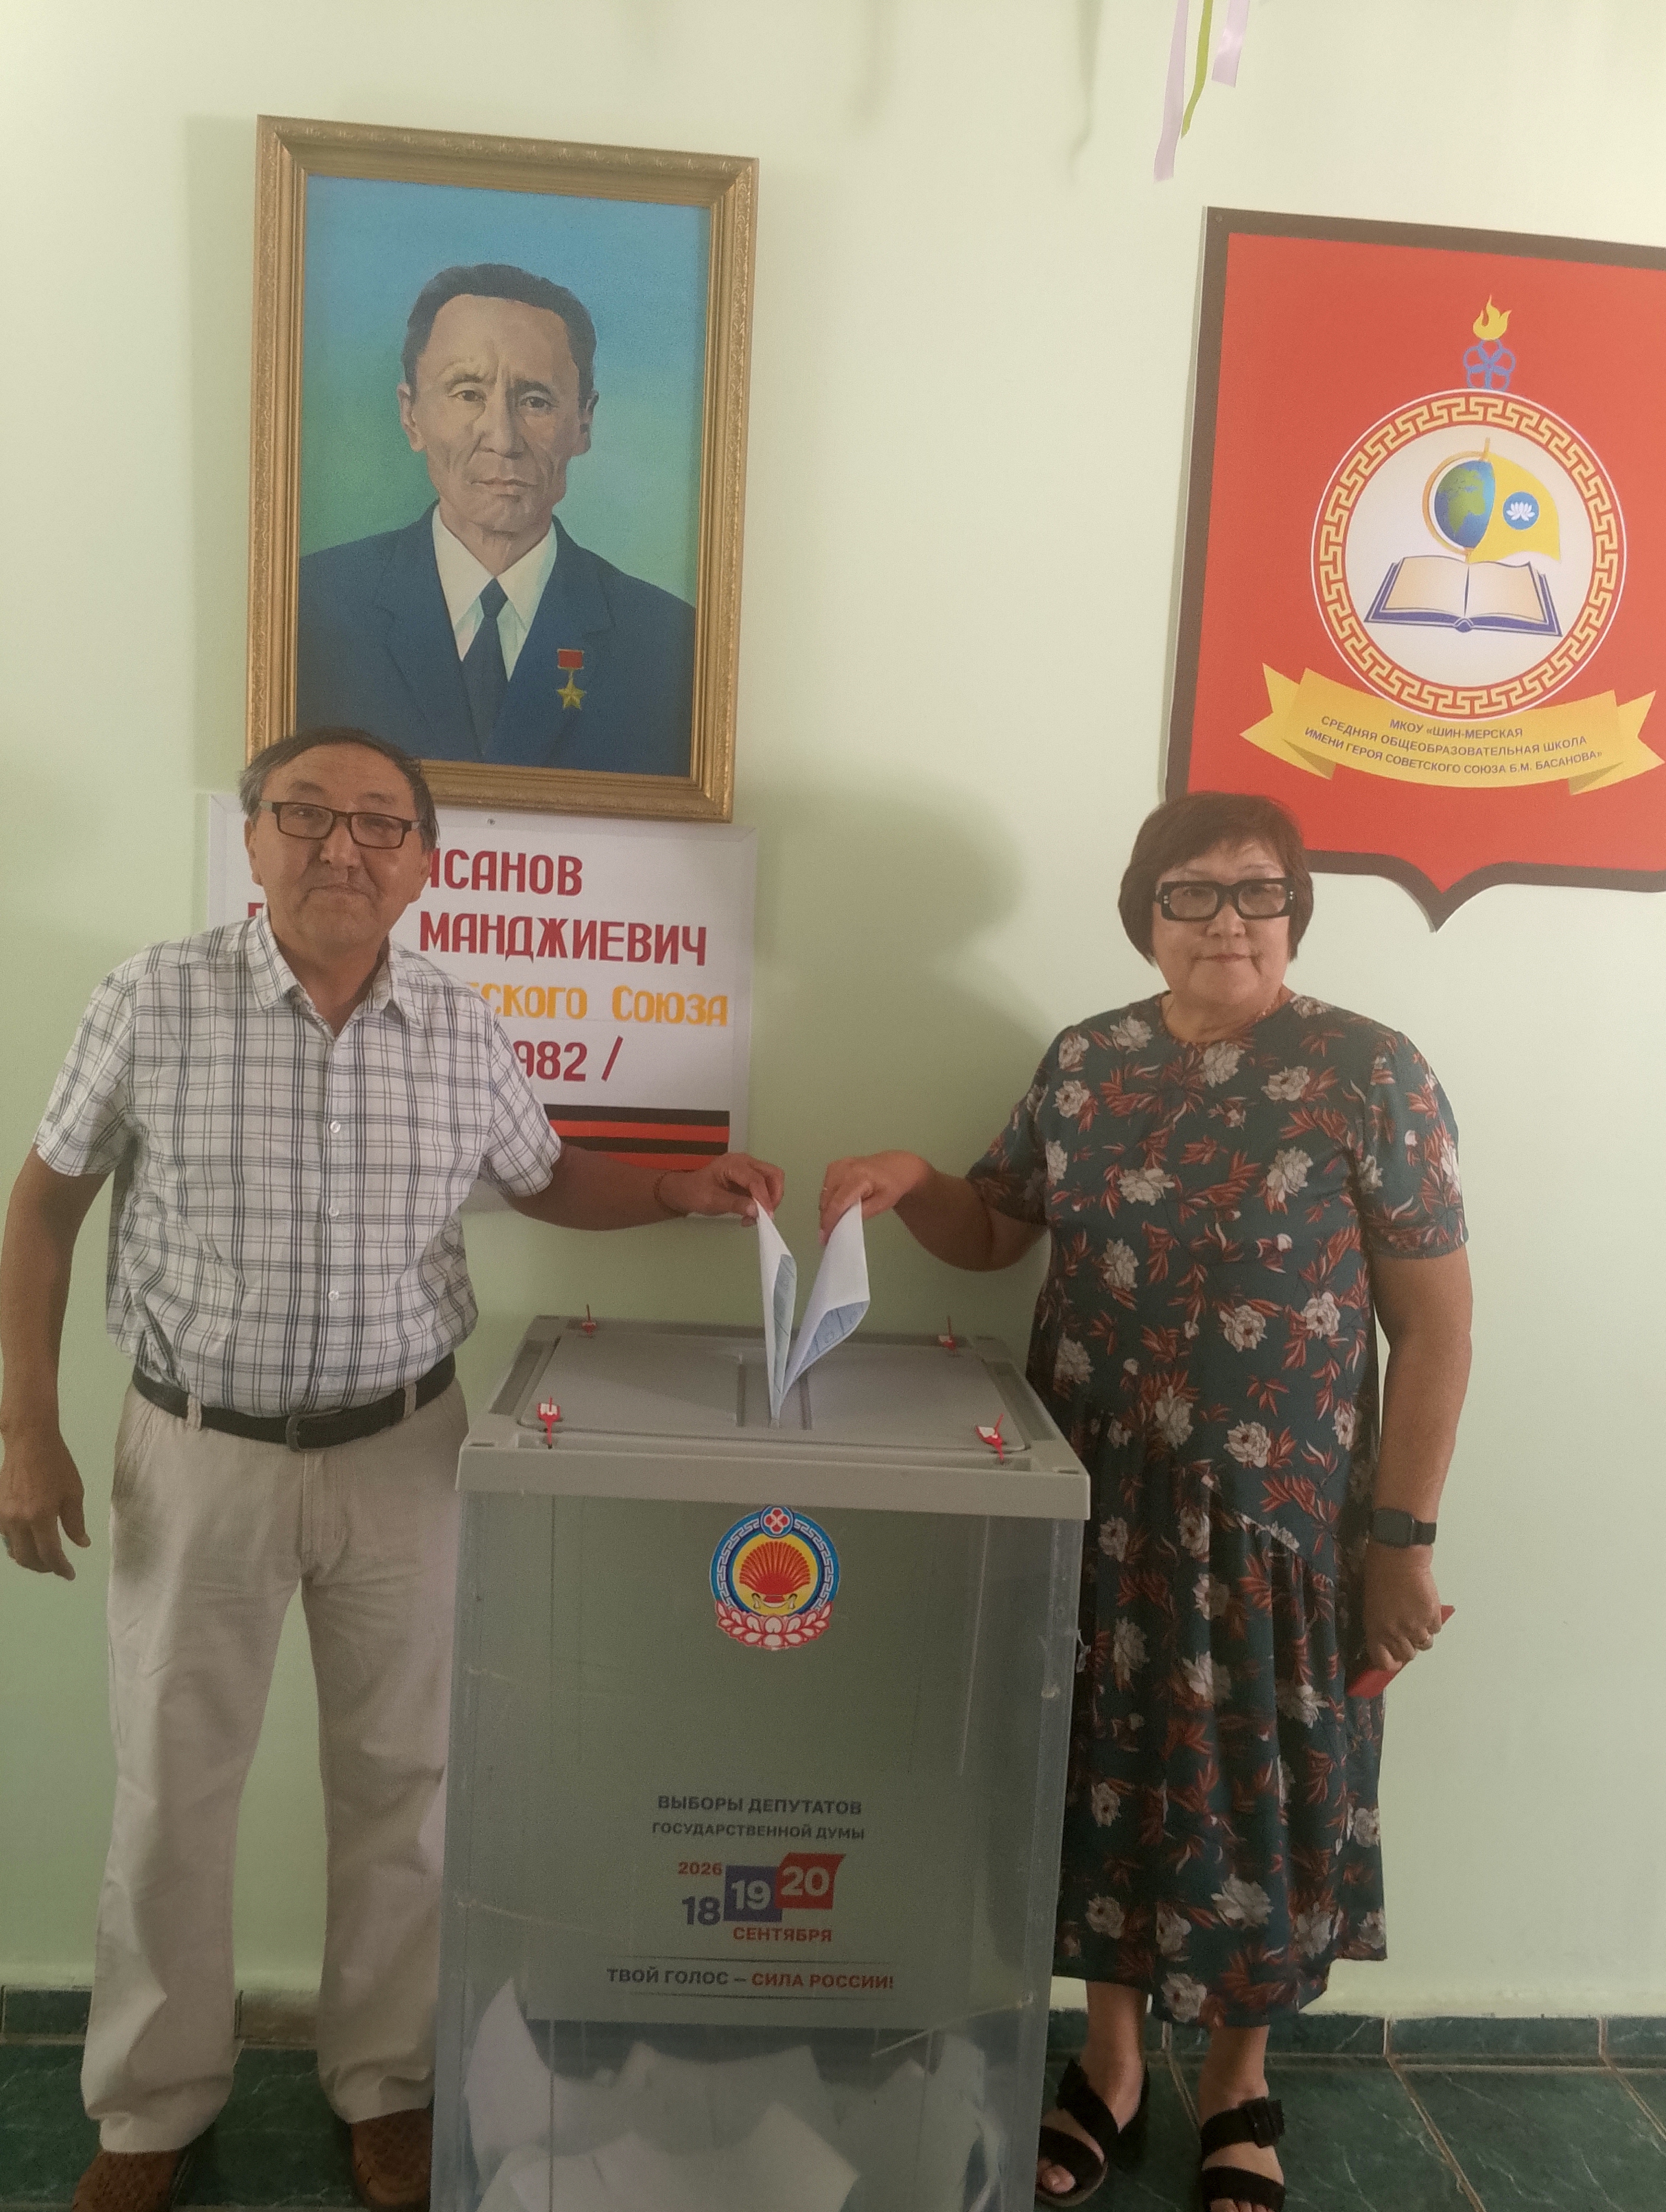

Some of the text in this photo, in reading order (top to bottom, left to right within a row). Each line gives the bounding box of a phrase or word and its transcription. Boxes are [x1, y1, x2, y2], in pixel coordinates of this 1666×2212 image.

[1321, 716, 1587, 757] СРЕДНЯЯ ОБЩЕОБРАЗОВАТЕЛЬНАЯ ШКОЛА
[1389, 719, 1522, 739] МКОУ «ШИН-МЕРСКАЯ
[1305, 727, 1344, 749] ИМЕНИ
[1345, 743, 1383, 761] ГЕРОЯ
[1386, 754, 1461, 774] СОВЕТСКОГО
[1464, 765, 1506, 774] СОЮЗА
[1536, 750, 1603, 770] БАСАНОВА»
[419, 911, 707, 967] МАНДЖИЕВИЧ
[658, 1795, 862, 1815] ВЫБОРЫ ДЕПУТАТОВ
[652, 1822, 864, 1840] ГОСУДАРСТВЕННОЙ ДУМЫ
[678, 1862, 722, 1876] 2026
[682, 1866, 830, 1925] 18 19 20
[733, 1927, 832, 1943] СЕНТЯБРЯ
[606, 1966, 659, 1983] ТВОЙ
[665, 1970, 729, 1985] ГОЛОС
[752, 1972, 804, 1986] СИЛА
[809, 1974, 894, 1989] РОССИИ!
